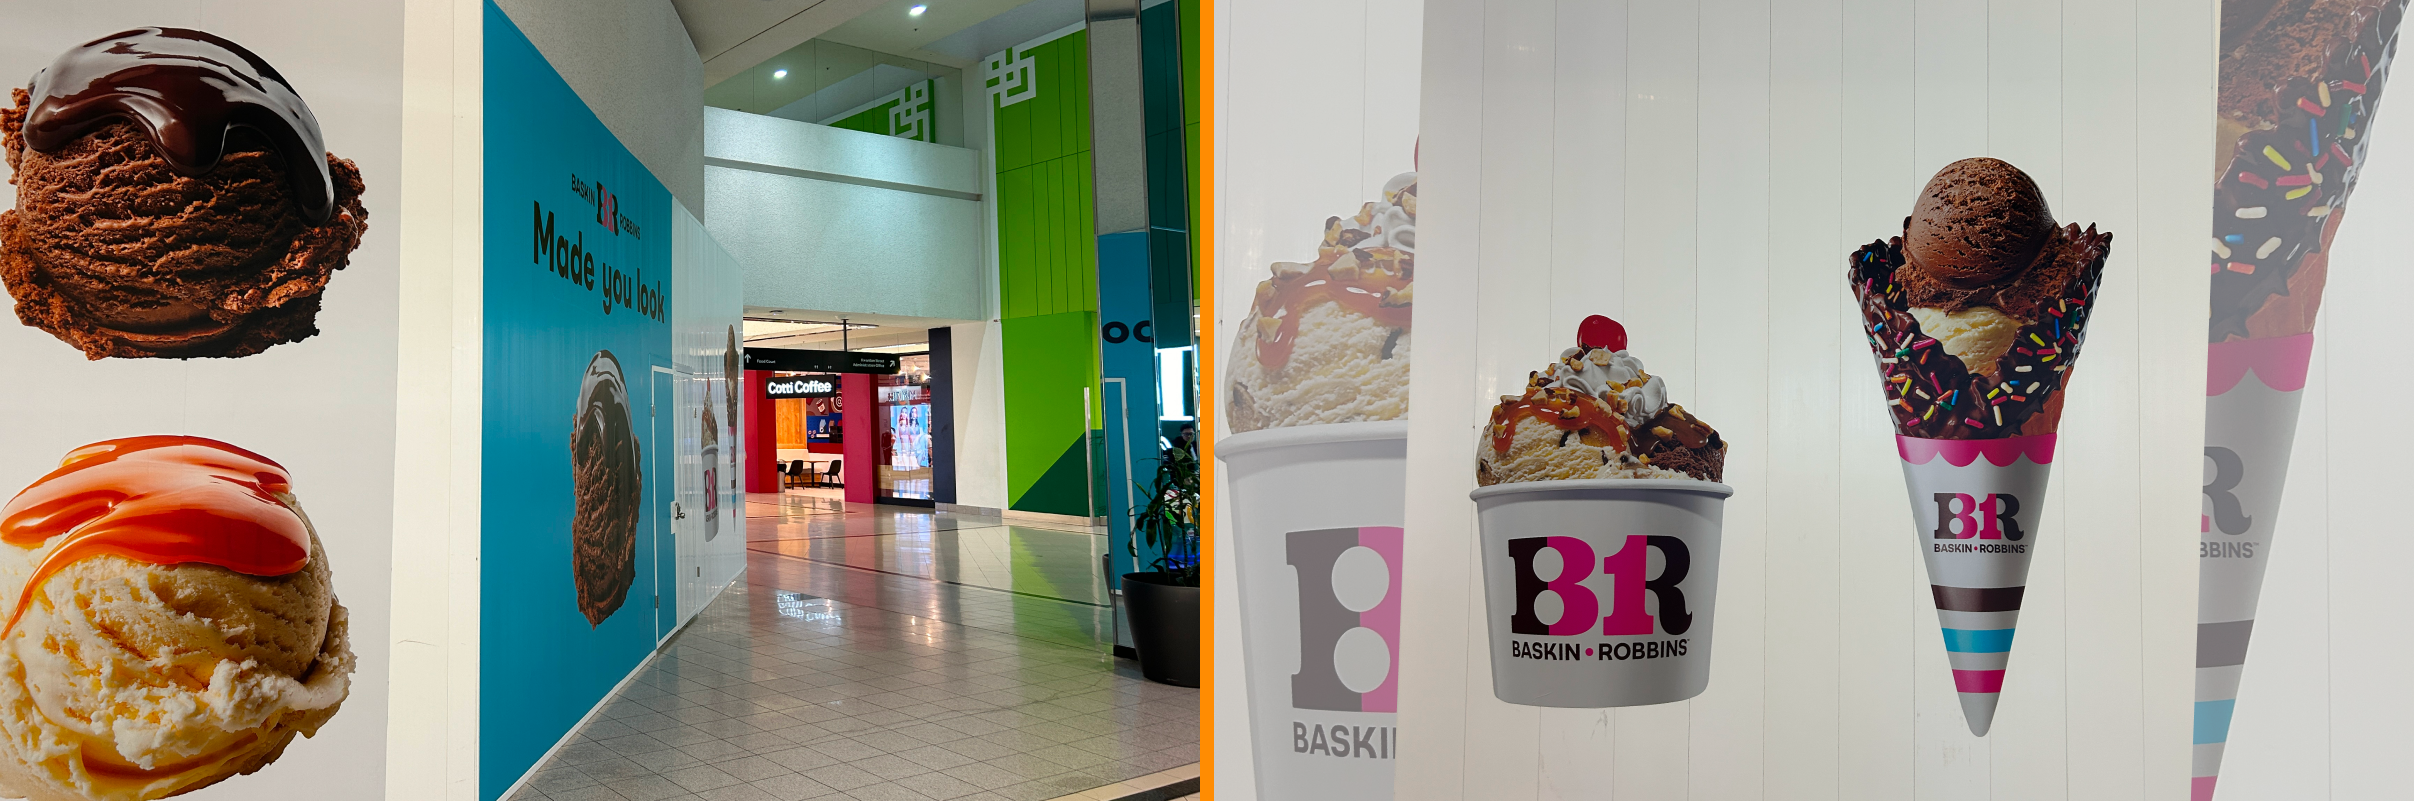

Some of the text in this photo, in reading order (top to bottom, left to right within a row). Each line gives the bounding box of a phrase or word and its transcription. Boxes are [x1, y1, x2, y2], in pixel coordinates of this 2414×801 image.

[572, 173, 595, 207] BASKIN
[620, 212, 641, 240] ROBBINS
[533, 200, 665, 324] Made you look
[768, 380, 832, 395] Cotti Coffee
[1934, 543, 1972, 553] BASKIN
[1512, 640, 1581, 661] BASKIN
[1293, 721, 1397, 760] BASKI
